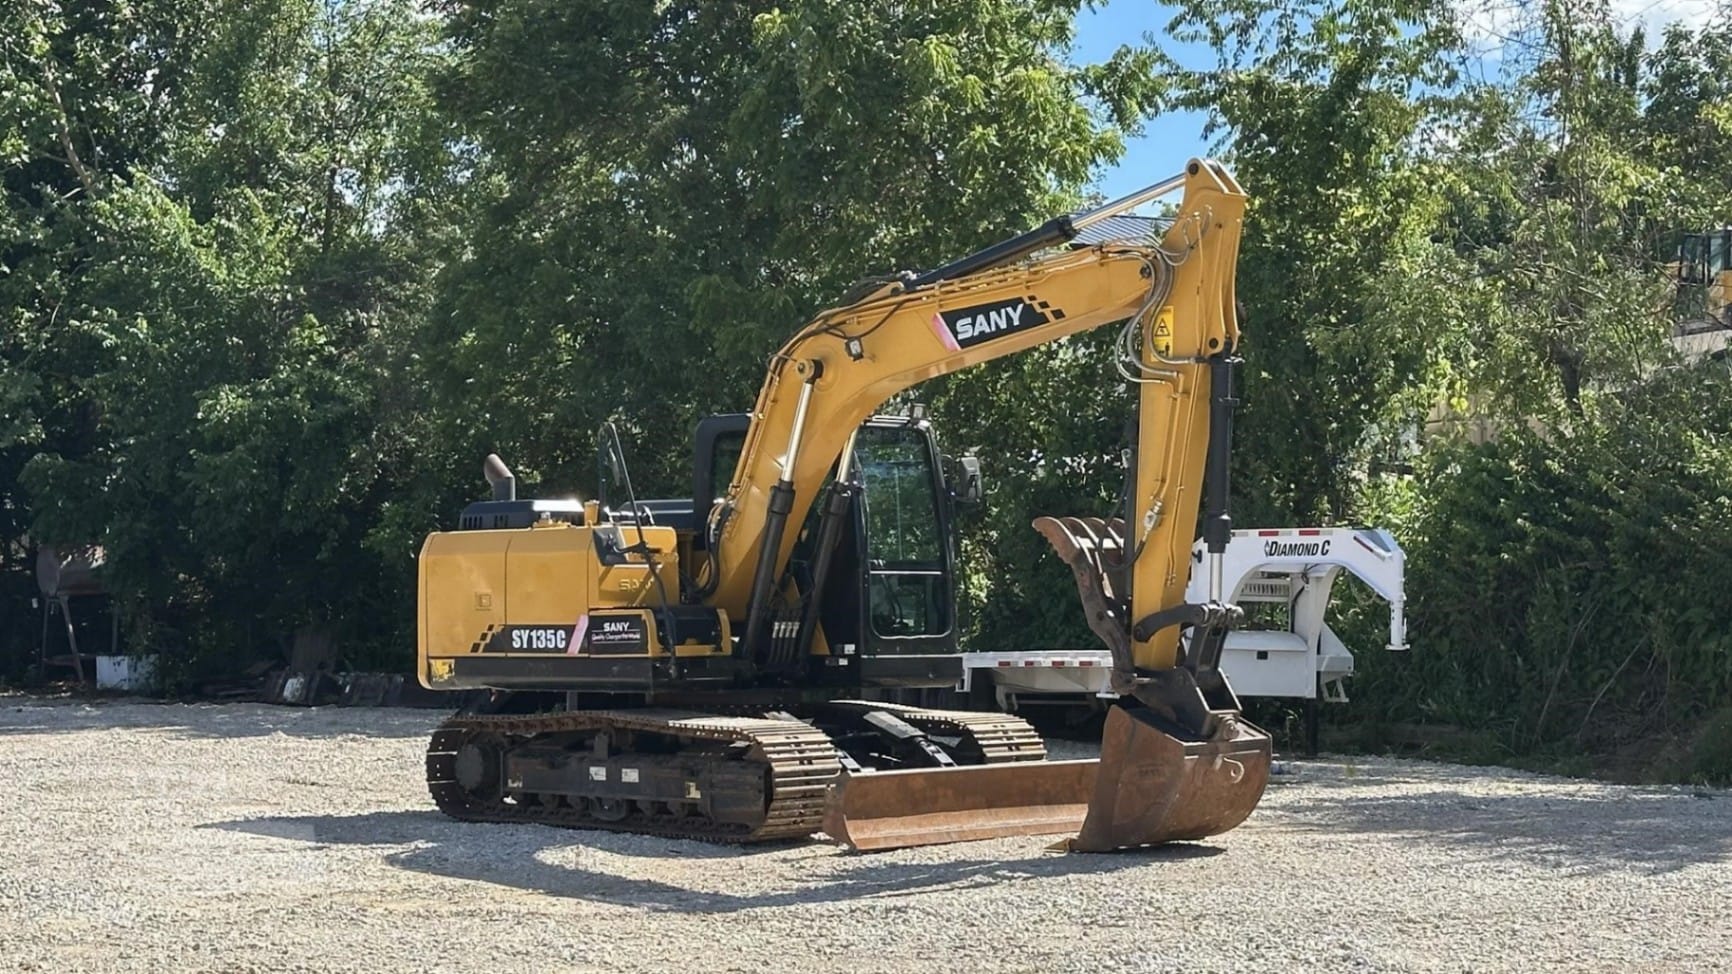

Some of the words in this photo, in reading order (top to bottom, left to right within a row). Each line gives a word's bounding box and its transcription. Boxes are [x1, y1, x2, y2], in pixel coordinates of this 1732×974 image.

[956, 303, 1024, 341] SANY
[1268, 540, 1318, 557] DIAMOND
[1321, 539, 1331, 556] C
[603, 621, 630, 632] SANY
[512, 629, 566, 649] SY135C
